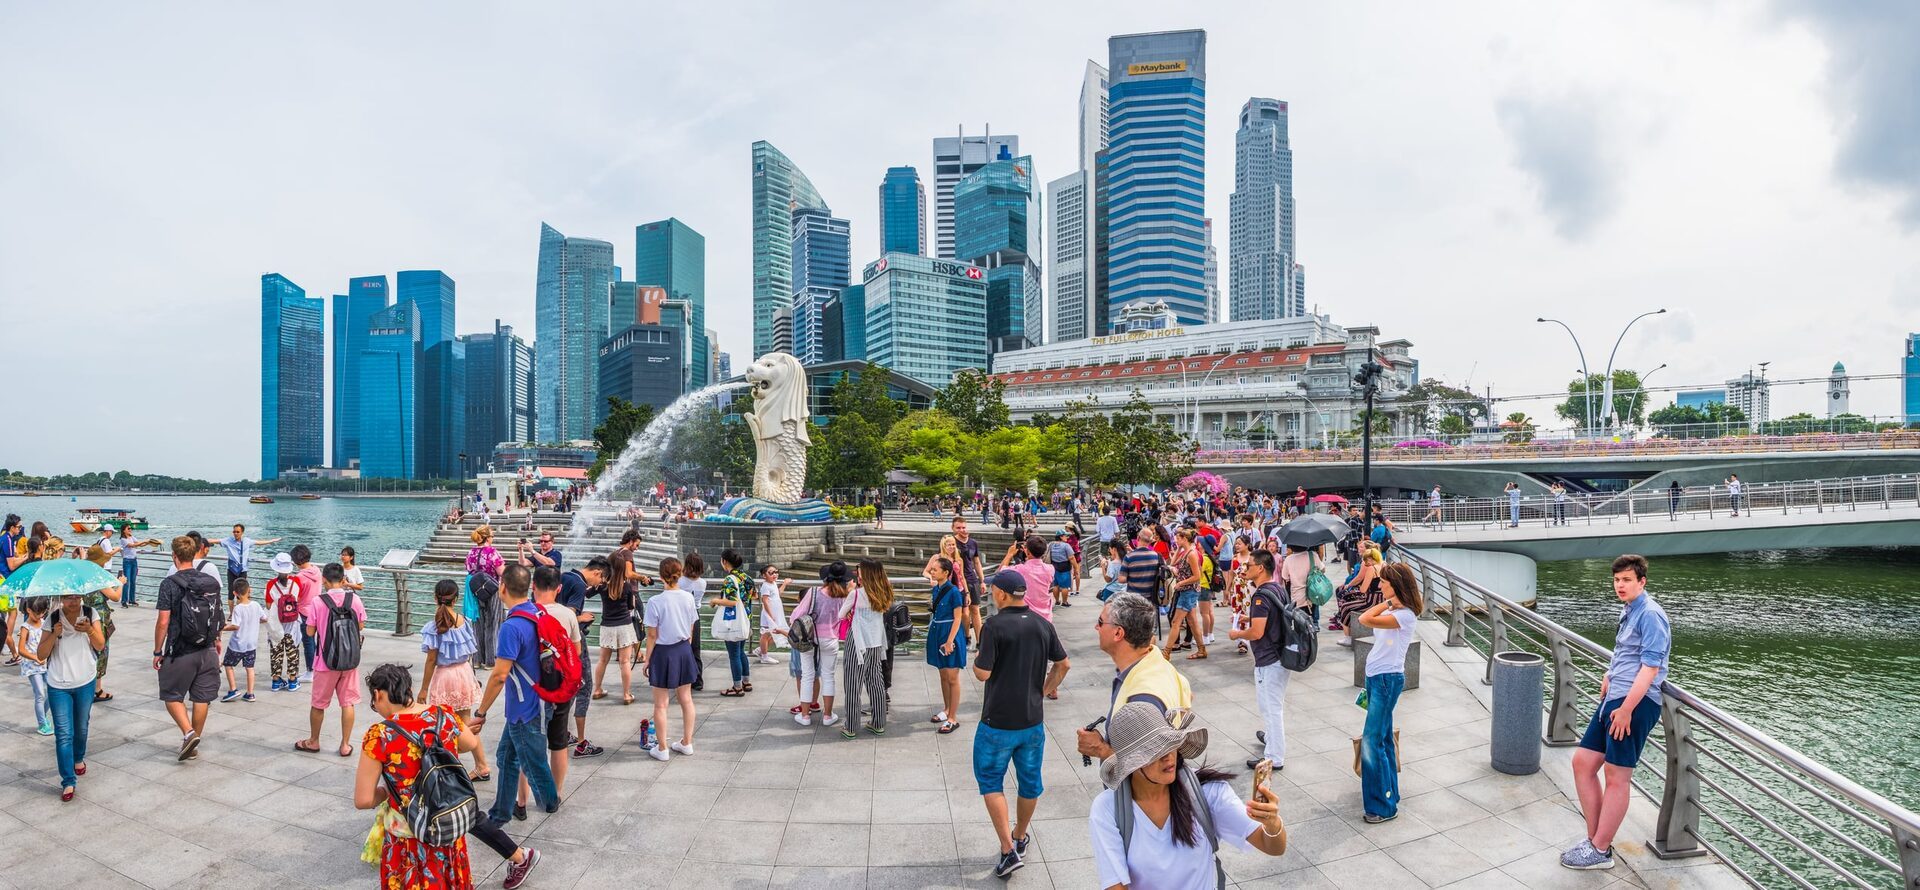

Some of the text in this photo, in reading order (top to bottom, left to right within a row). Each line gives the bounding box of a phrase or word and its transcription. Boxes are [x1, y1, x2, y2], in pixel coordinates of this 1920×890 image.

[1140, 62, 1181, 72] Maybank
[931, 260, 966, 278] HSBC
[1091, 327, 1185, 346] THE FULLERTON HOTEL
